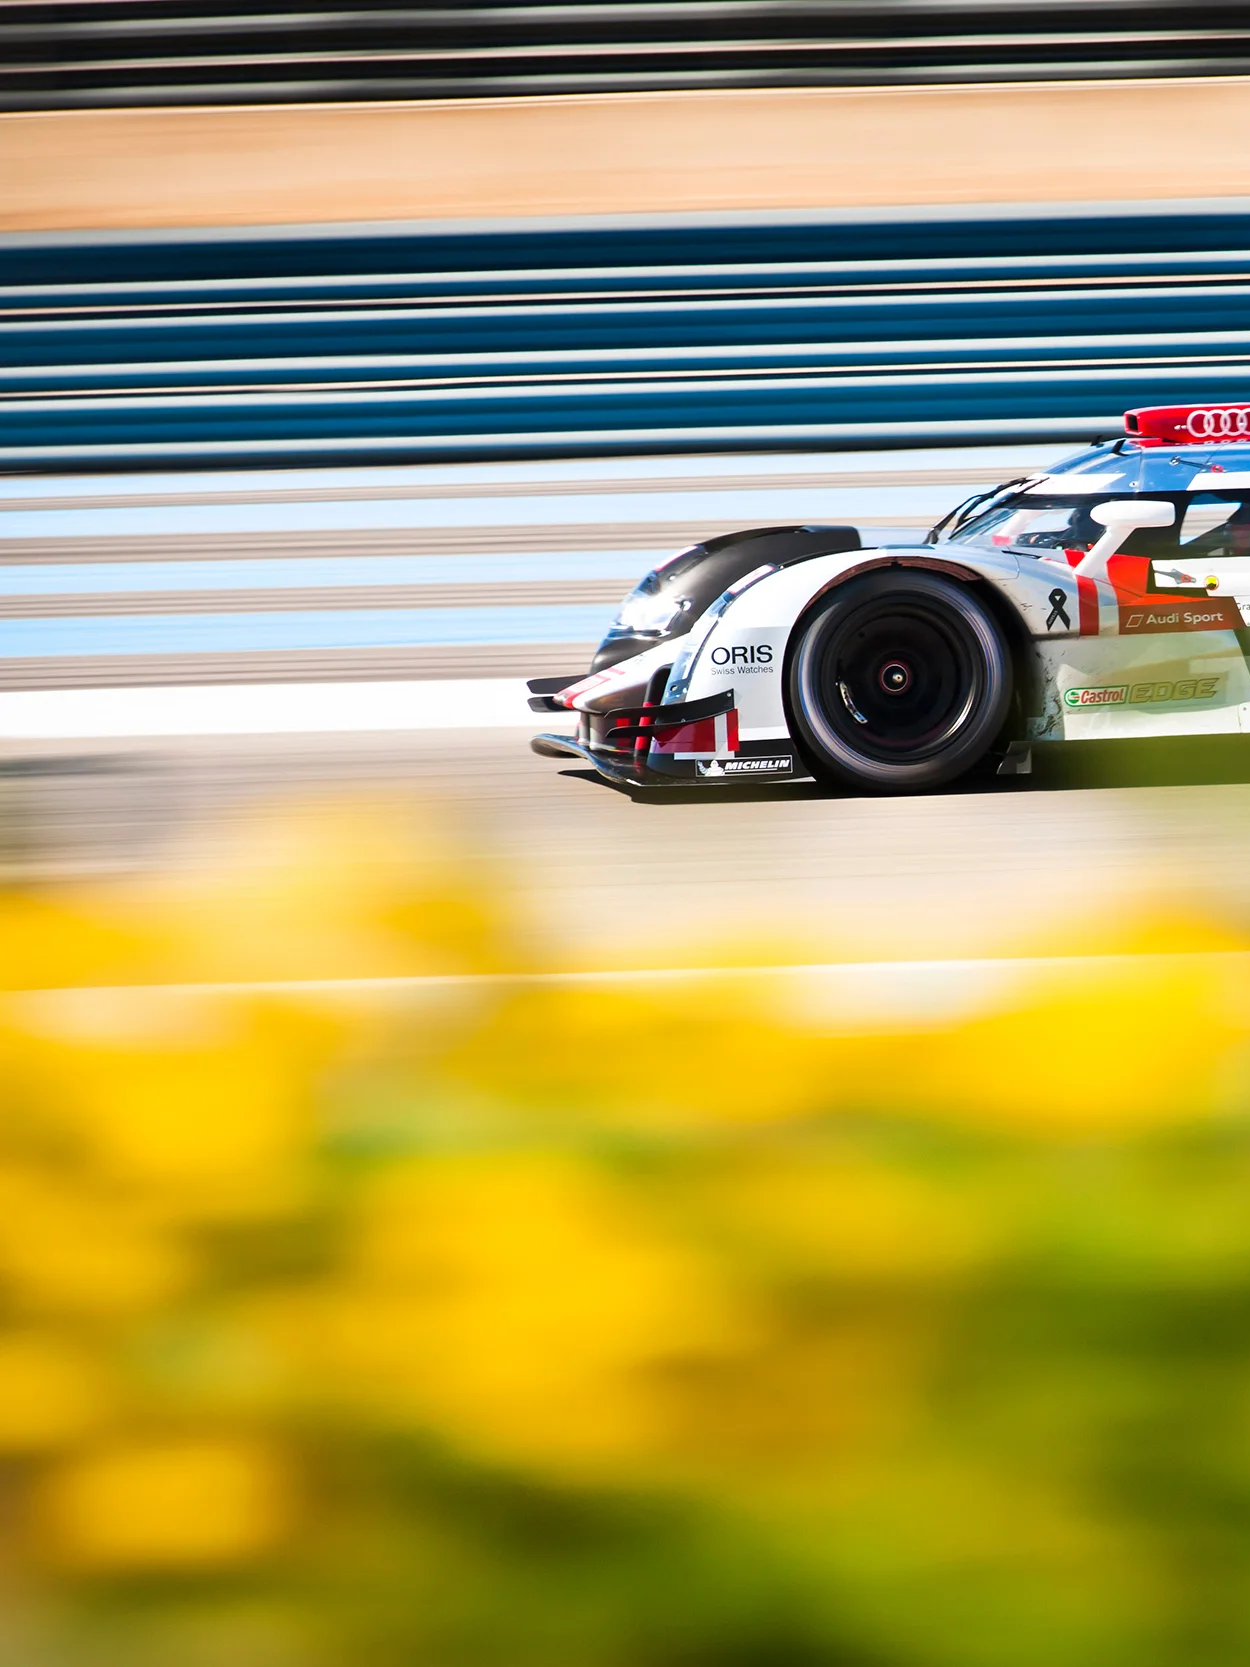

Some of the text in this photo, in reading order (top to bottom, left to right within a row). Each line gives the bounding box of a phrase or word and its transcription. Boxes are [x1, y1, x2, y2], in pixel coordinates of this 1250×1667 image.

[1146, 612, 1224, 625] Audi Sport
[711, 645, 773, 665] ORIS
[711, 665, 774, 676] Swiss Watches
[1080, 677, 1220, 704] Castrol EDGE
[724, 759, 790, 771] MICHELIN
